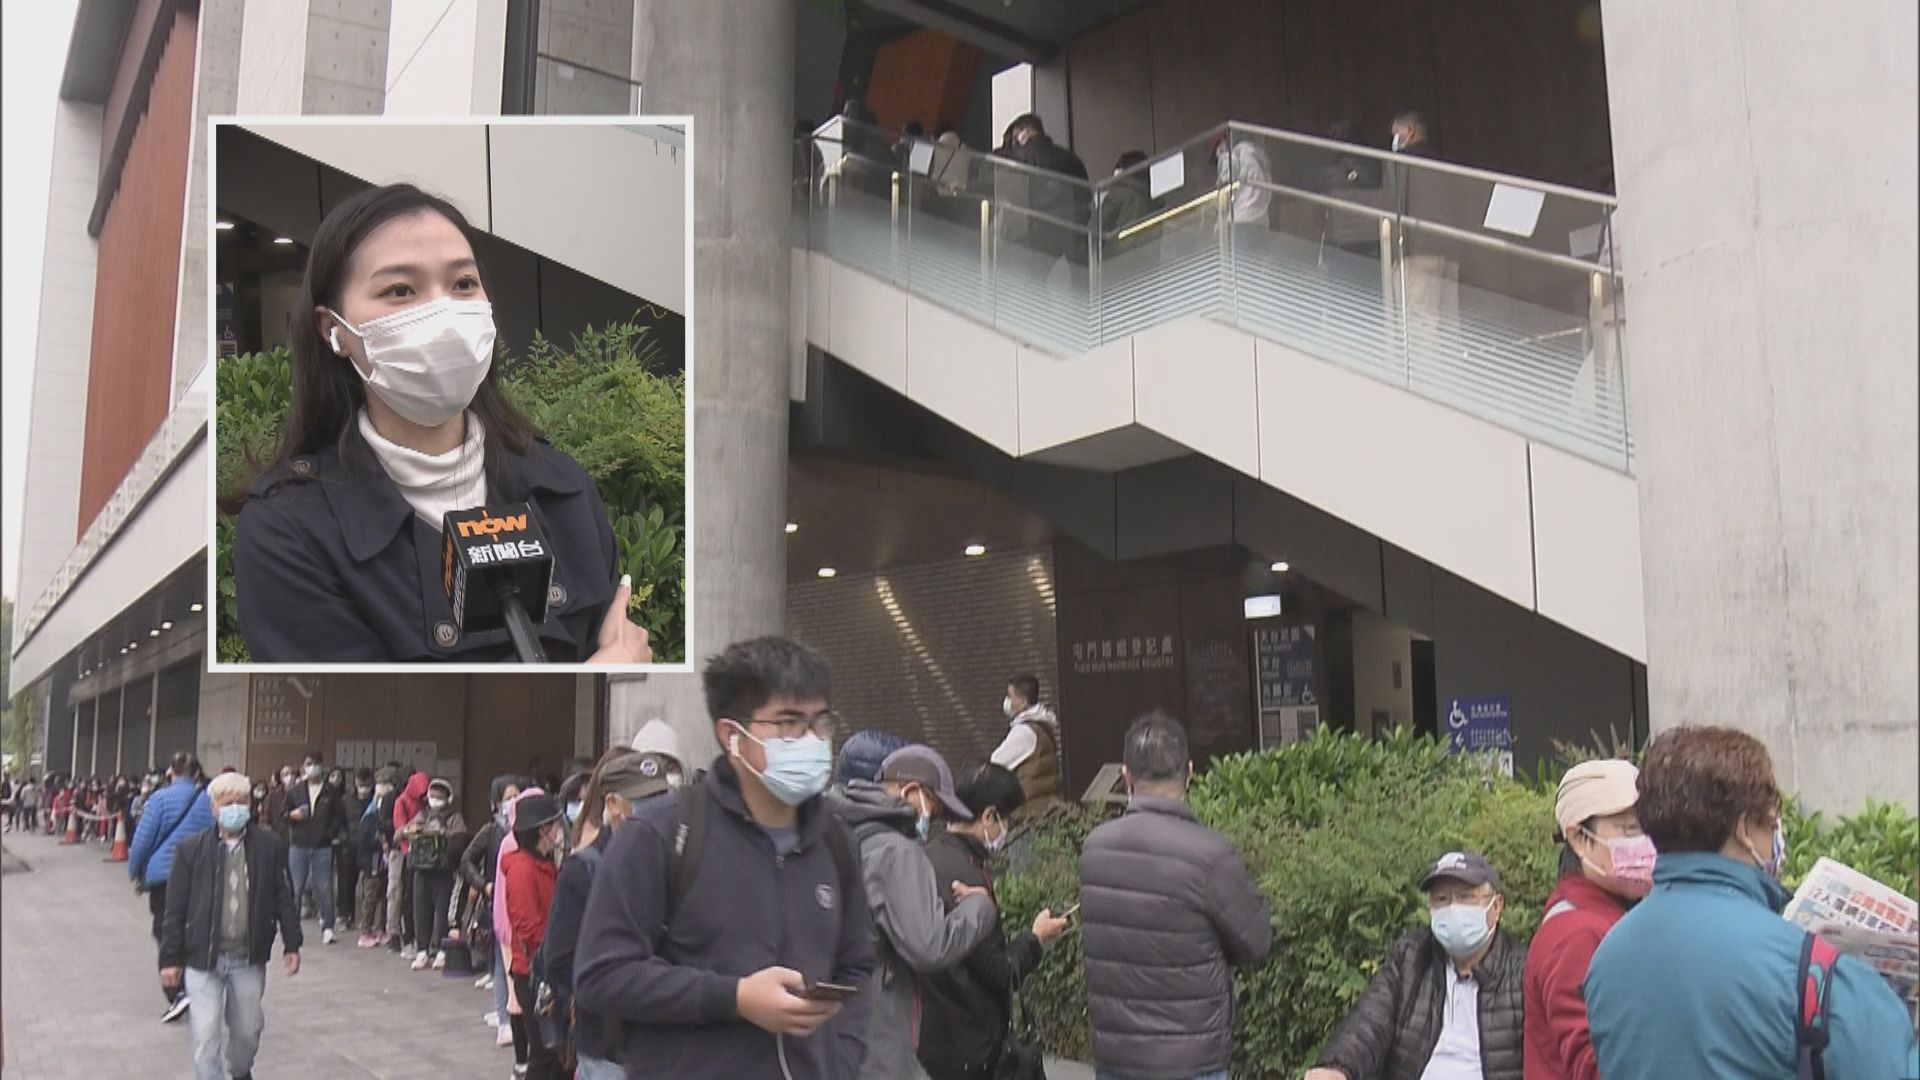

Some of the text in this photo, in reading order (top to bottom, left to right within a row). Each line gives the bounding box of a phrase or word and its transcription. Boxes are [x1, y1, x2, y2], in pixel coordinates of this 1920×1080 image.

[457, 512, 527, 540] now
[467, 539, 544, 564] 新聞台
